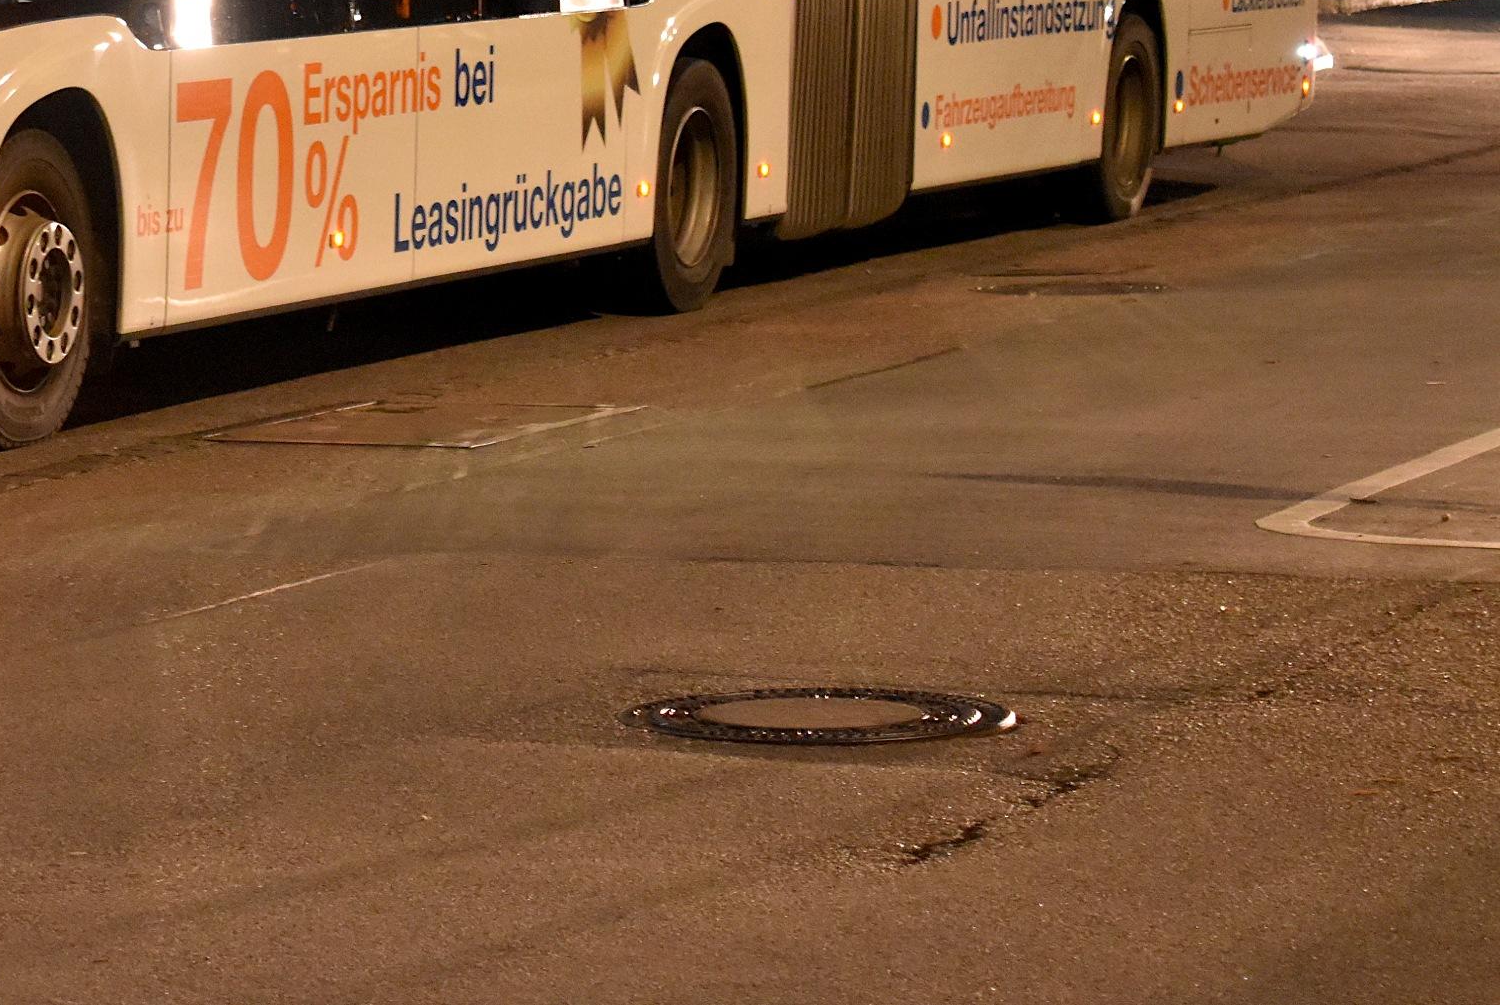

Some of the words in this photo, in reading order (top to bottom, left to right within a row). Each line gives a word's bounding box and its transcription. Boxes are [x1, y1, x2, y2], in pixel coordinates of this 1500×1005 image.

[304, 52, 442, 135] Ersparnis
[454, 45, 495, 108] bei
[136, 196, 161, 238] bis
[165, 204, 184, 233] zu
[176, 70, 294, 291] 70
[393, 162, 622, 252] Leasingrückgabe
